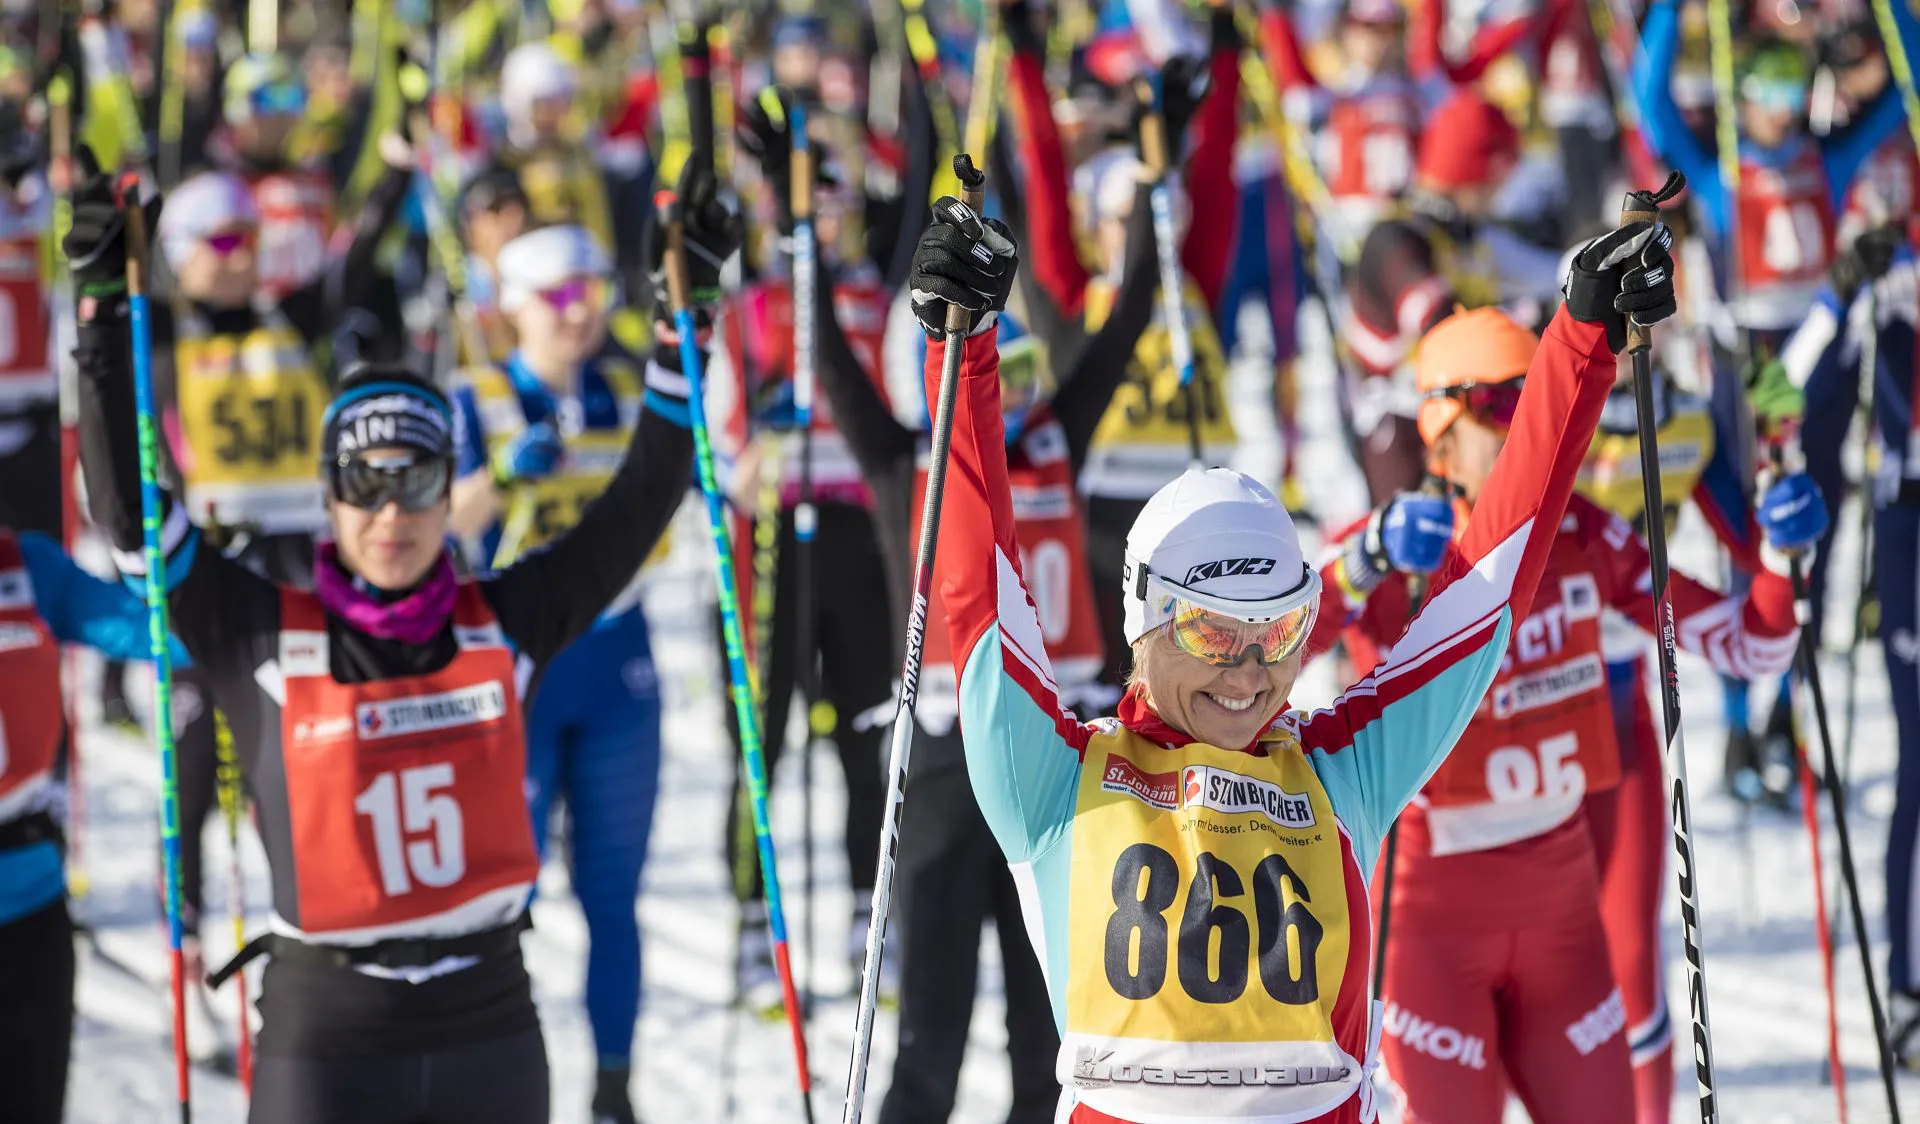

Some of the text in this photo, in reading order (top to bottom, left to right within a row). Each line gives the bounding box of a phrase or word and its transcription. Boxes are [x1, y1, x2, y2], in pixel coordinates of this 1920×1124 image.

[903, 591, 927, 706] MADSHUS
[354, 762, 467, 898] 15
[1128, 776, 1177, 801] Johann
[1207, 818, 1246, 834] besser.
[1104, 843, 1324, 1005] 866
[1384, 1001, 1487, 1071] UKOIL
